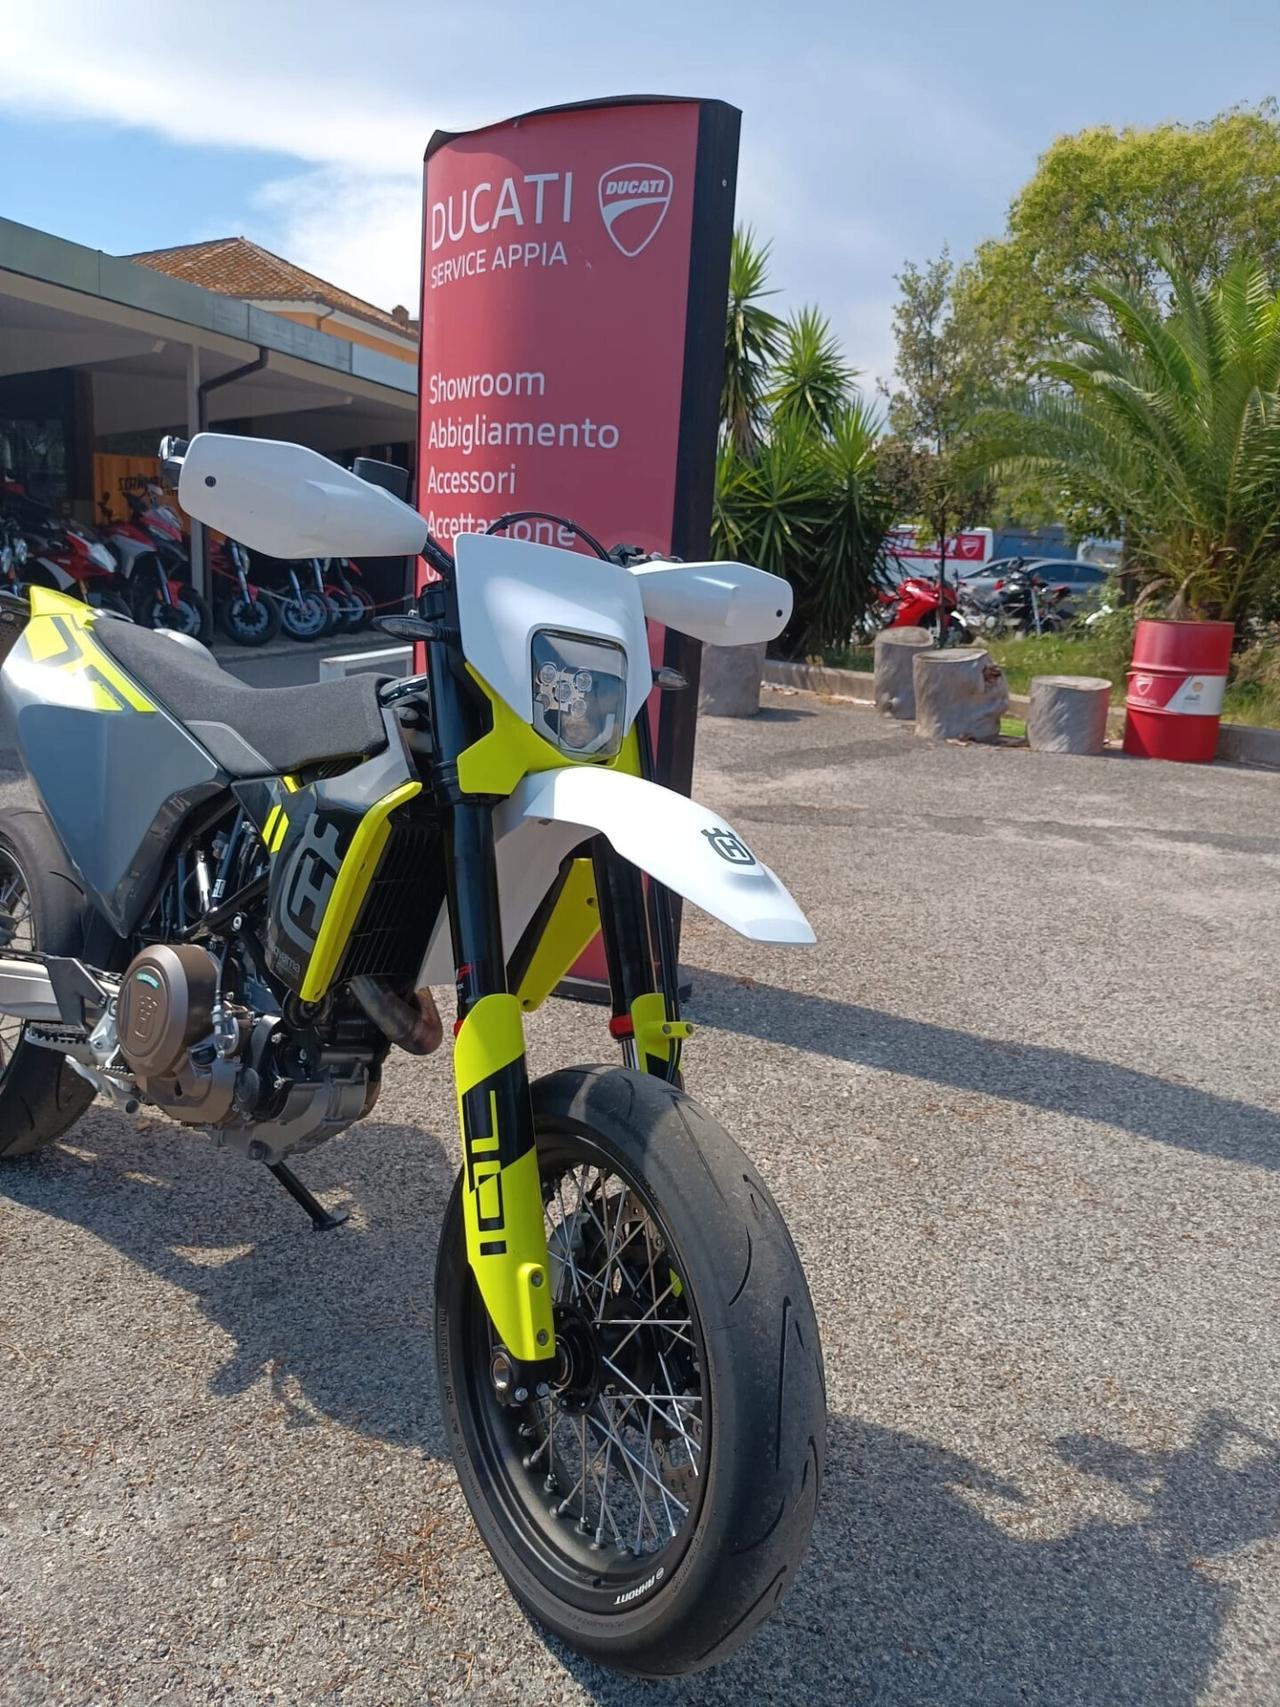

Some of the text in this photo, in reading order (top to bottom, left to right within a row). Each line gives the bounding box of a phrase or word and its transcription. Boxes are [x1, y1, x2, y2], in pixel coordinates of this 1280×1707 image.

[606, 179, 665, 195] DUCATI
[431, 172, 573, 250] DUCATI
[430, 241, 569, 289] SERVICE APPIA
[429, 370, 545, 404] Showroom
[429, 414, 619, 454] Abbigliamento
[427, 463, 517, 495] Accessori
